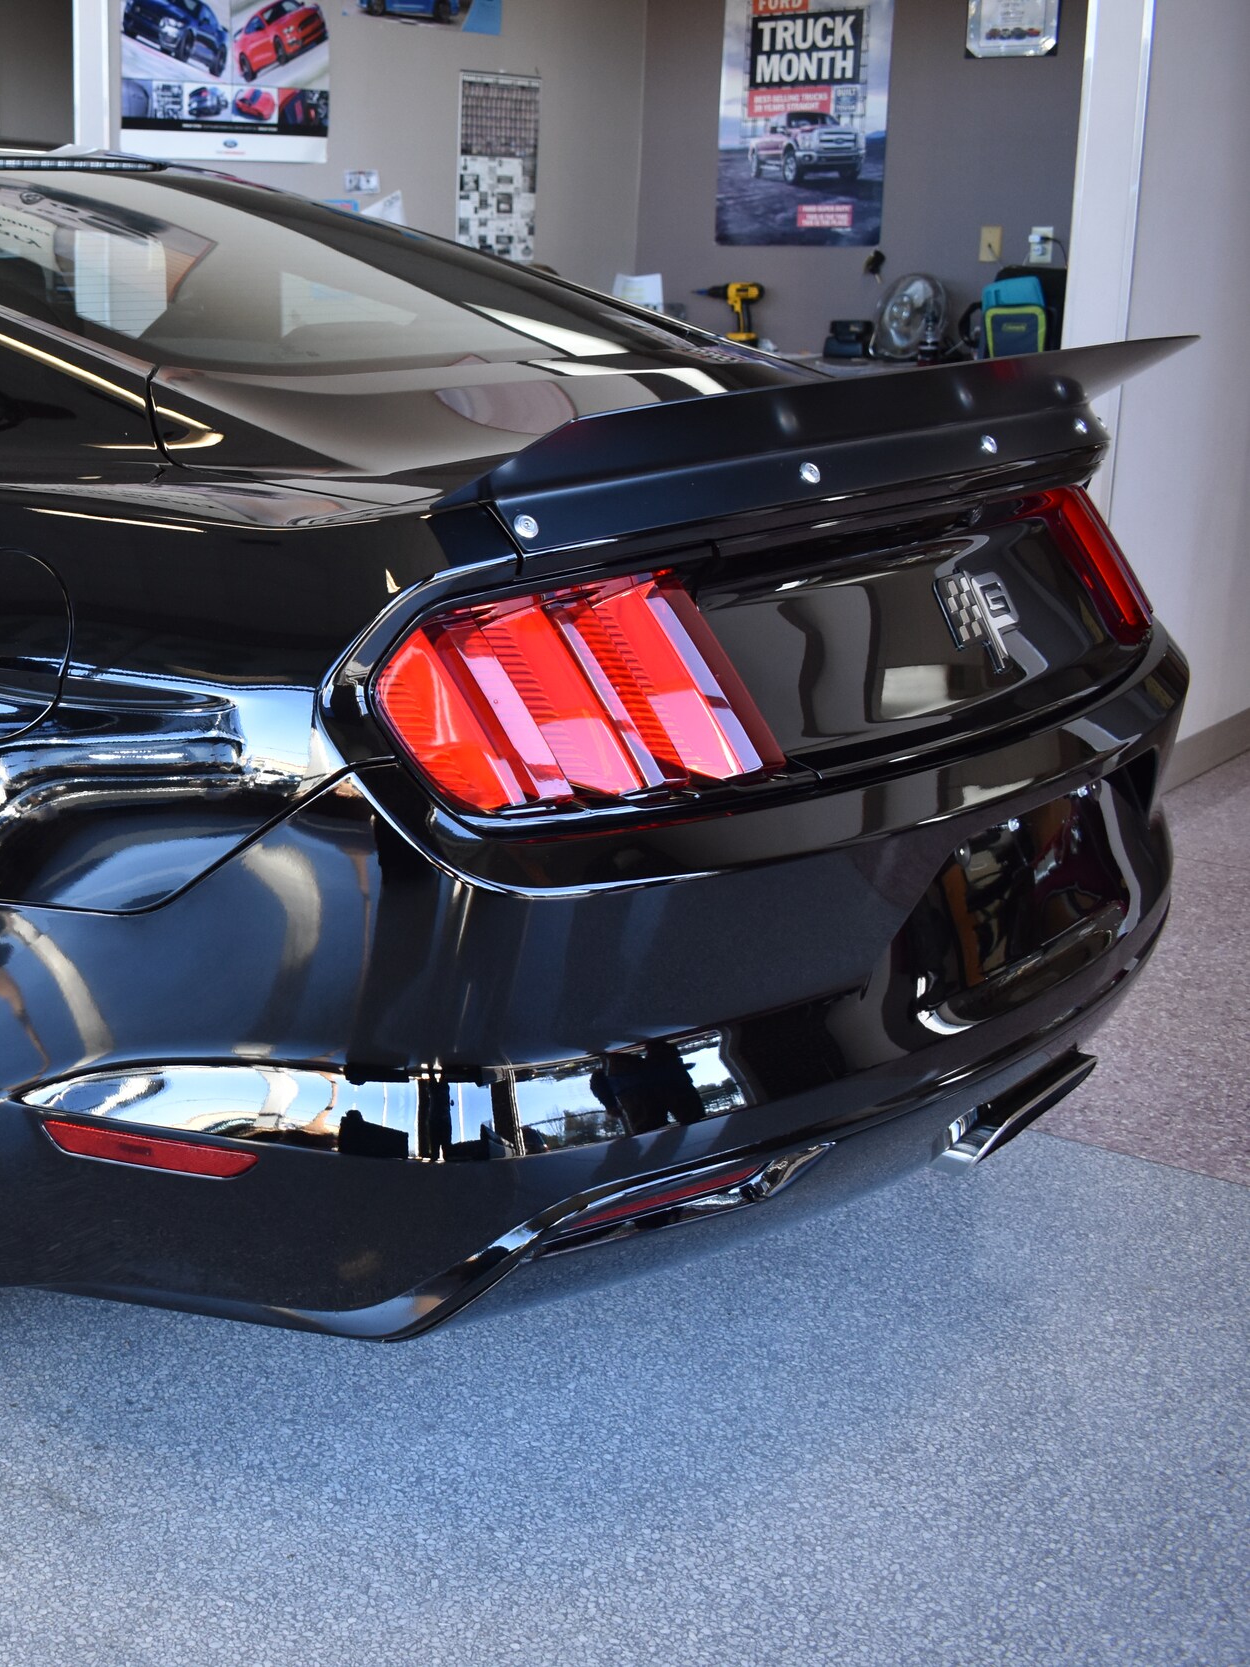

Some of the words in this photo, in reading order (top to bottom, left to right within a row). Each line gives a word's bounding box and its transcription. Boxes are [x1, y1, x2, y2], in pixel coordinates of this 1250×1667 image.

[758, 0, 803, 11] FORD
[758, 15, 856, 52] TRUCK
[755, 50, 854, 83] MONTH
